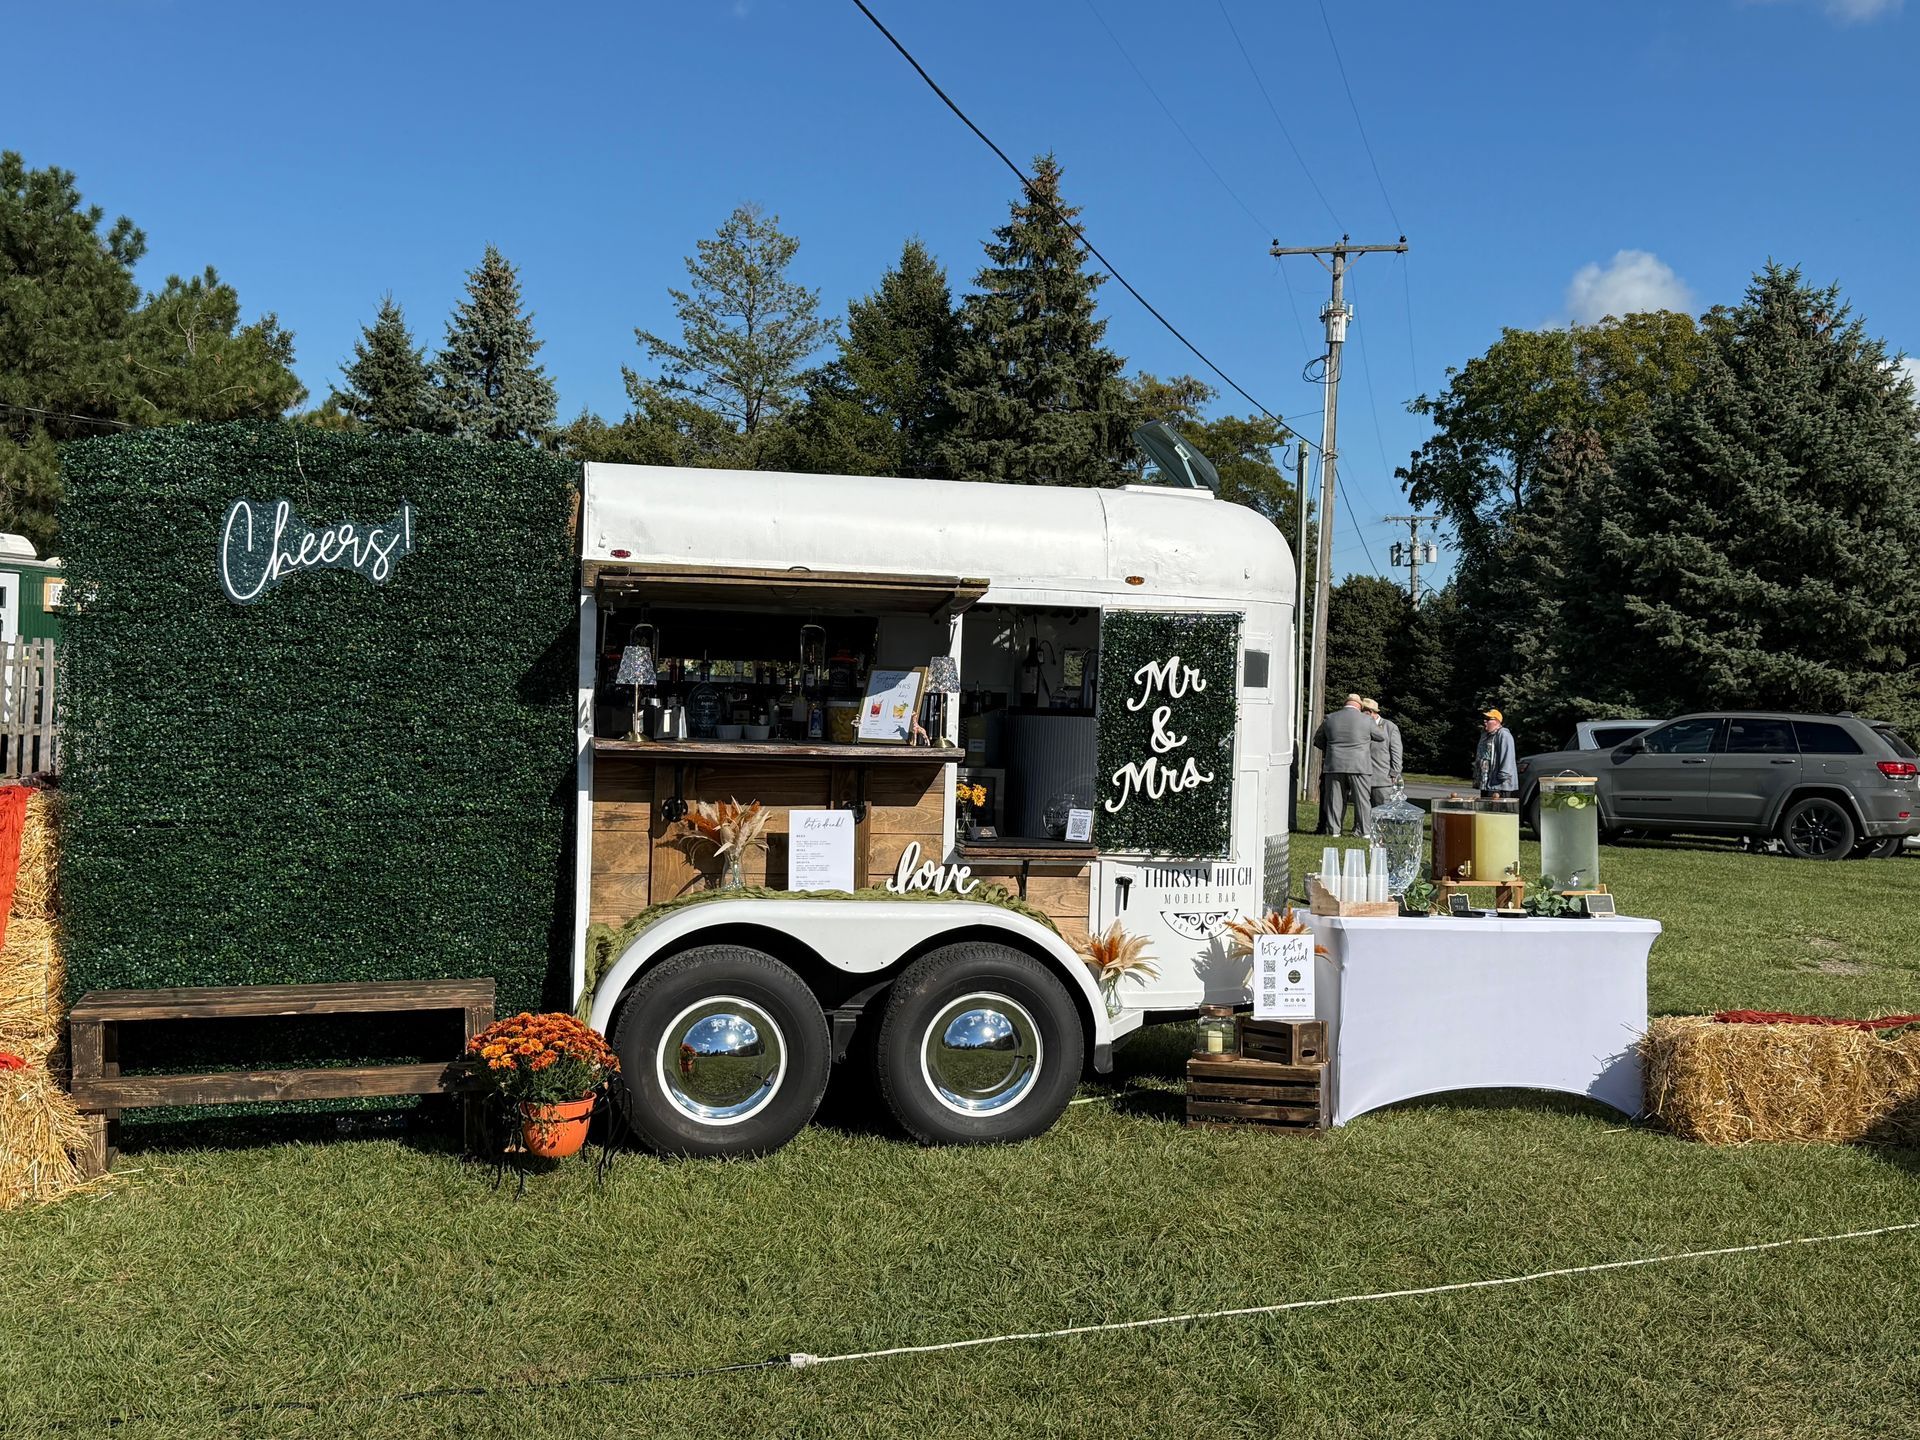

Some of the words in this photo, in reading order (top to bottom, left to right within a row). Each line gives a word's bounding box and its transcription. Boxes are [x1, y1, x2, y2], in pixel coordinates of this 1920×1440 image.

[221, 500, 412, 600] Cheers!
[1126, 655, 1207, 712] Mr
[1150, 706, 1188, 753] &
[1105, 756, 1214, 813] Mrs
[885, 841, 980, 895] love
[1144, 868, 1212, 888] THIRSTY
[1216, 867, 1252, 887] HITCH
[1164, 893, 1210, 904] MOBILE
[1218, 892, 1236, 903] BAR
[1282, 938, 1299, 957] get
[1283, 947, 1308, 967] social
